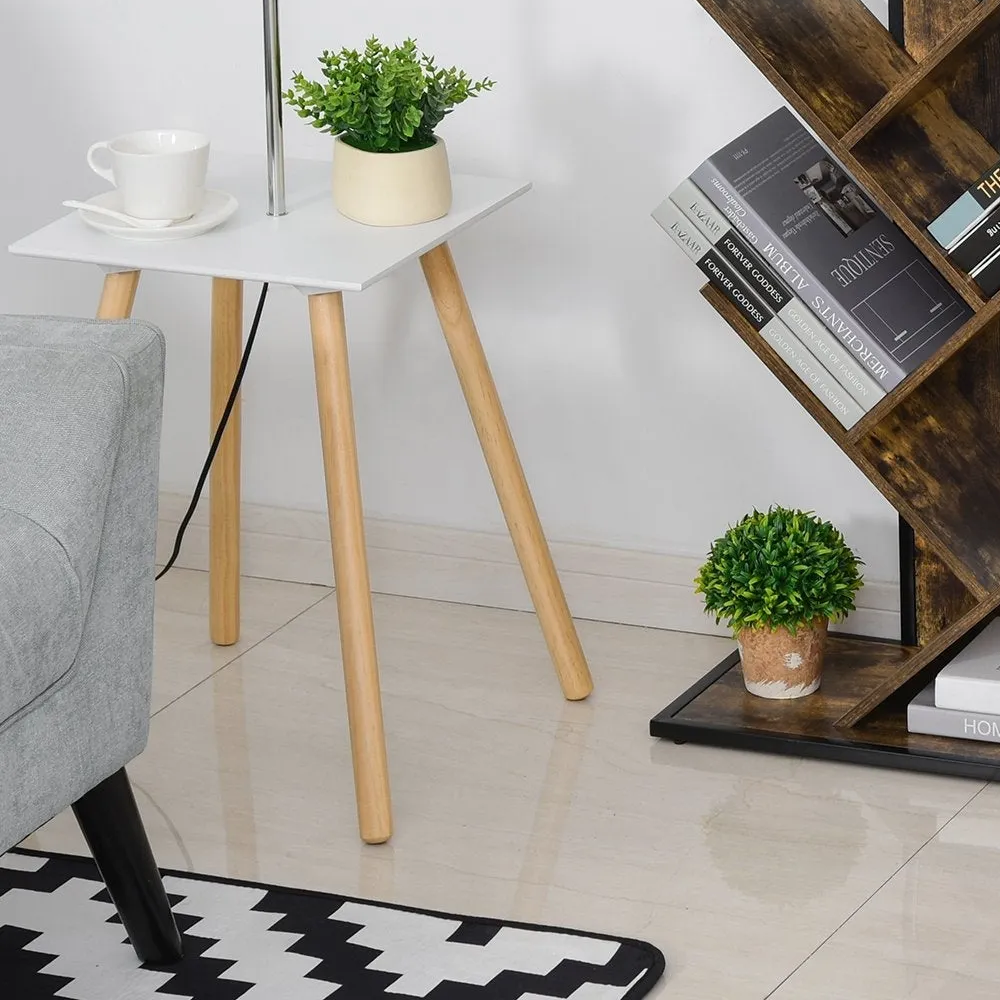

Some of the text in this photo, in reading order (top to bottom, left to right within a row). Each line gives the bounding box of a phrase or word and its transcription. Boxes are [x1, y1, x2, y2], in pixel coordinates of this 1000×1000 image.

[711, 177, 748, 218] Cloakrooms
[704, 258, 764, 323] FOREVER GODDESS
[724, 238, 783, 303] FOREVER GODDESS
[762, 243, 809, 290] ALBUM
[830, 234, 895, 287] SENTIQUE
[787, 309, 868, 397] GOLDEN AGE OF FASHION
[811, 295, 889, 380] MERCHANTS
[768, 328, 850, 416] GOLDEN AGE OF FASHION
